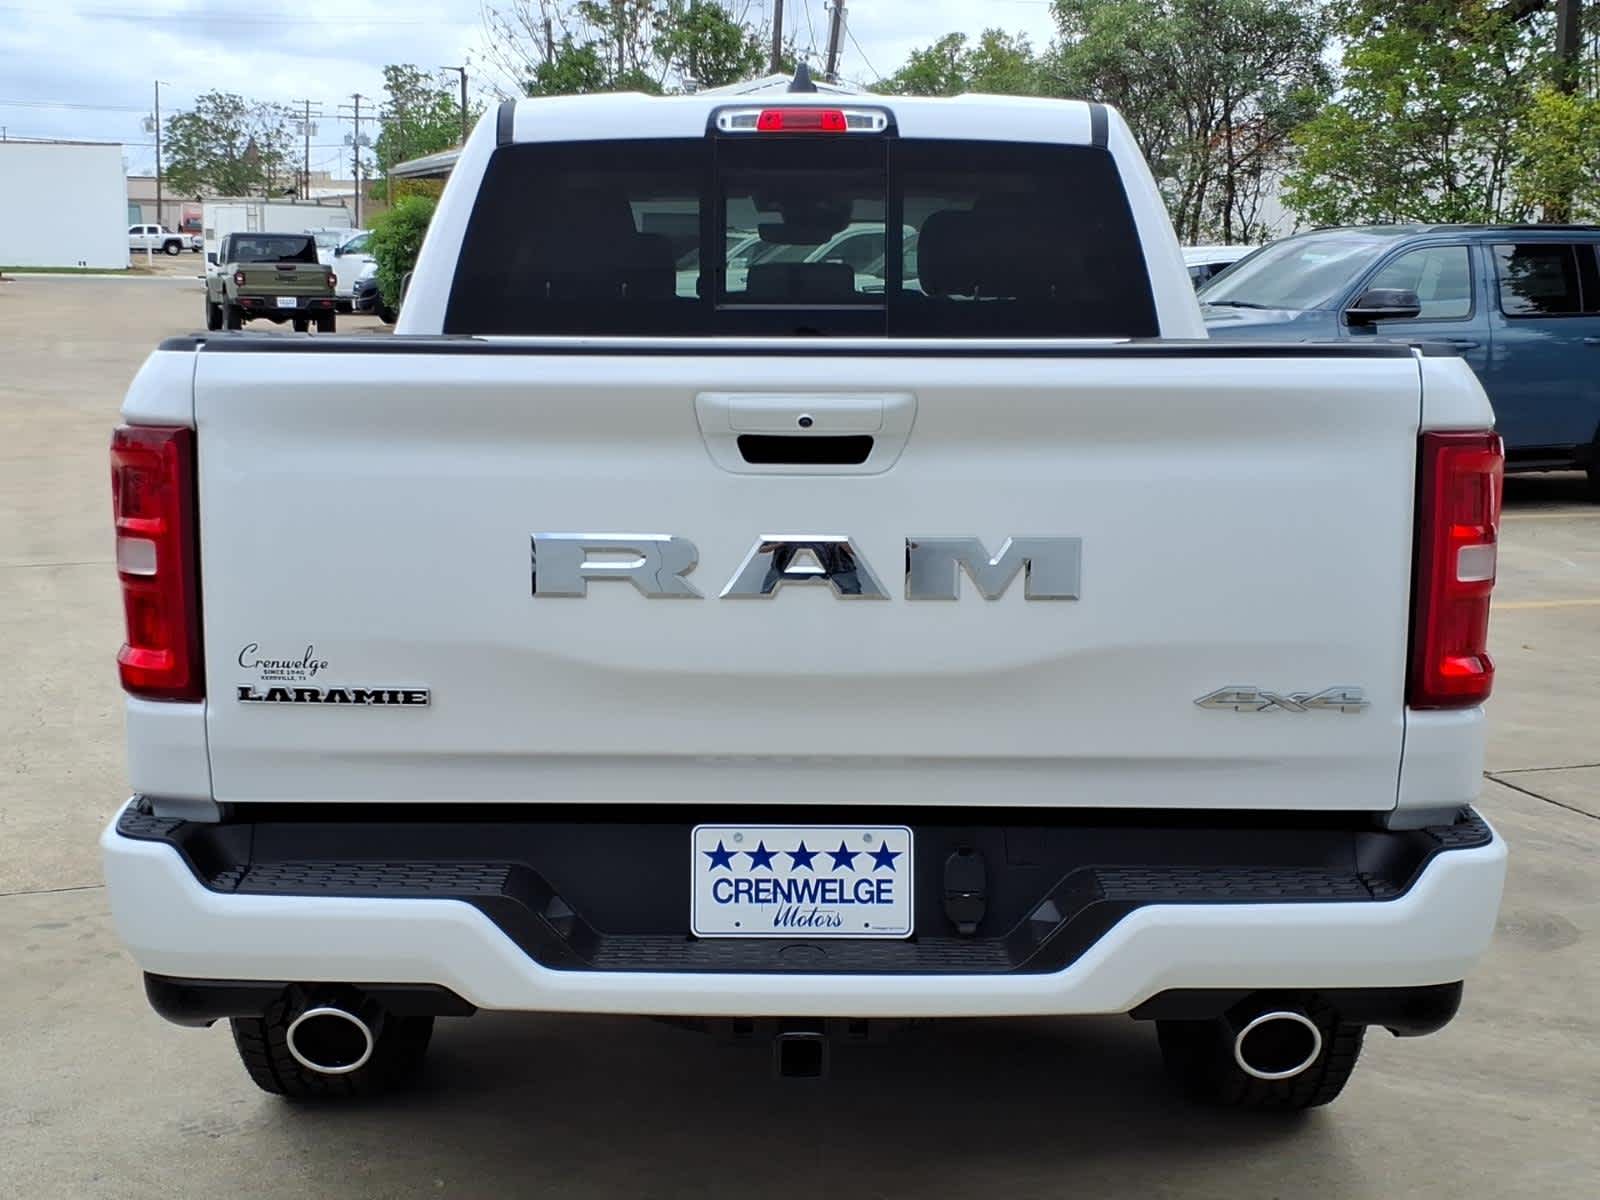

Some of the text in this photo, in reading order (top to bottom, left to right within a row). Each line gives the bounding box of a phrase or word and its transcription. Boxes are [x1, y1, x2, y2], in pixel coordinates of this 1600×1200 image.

[530, 532, 1083, 602] RAM
[238, 643, 328, 676] Crenwelge
[238, 686, 429, 706] LARAMIE
[712, 878, 894, 904] CRENWELGE
[773, 901, 843, 928] Motors
